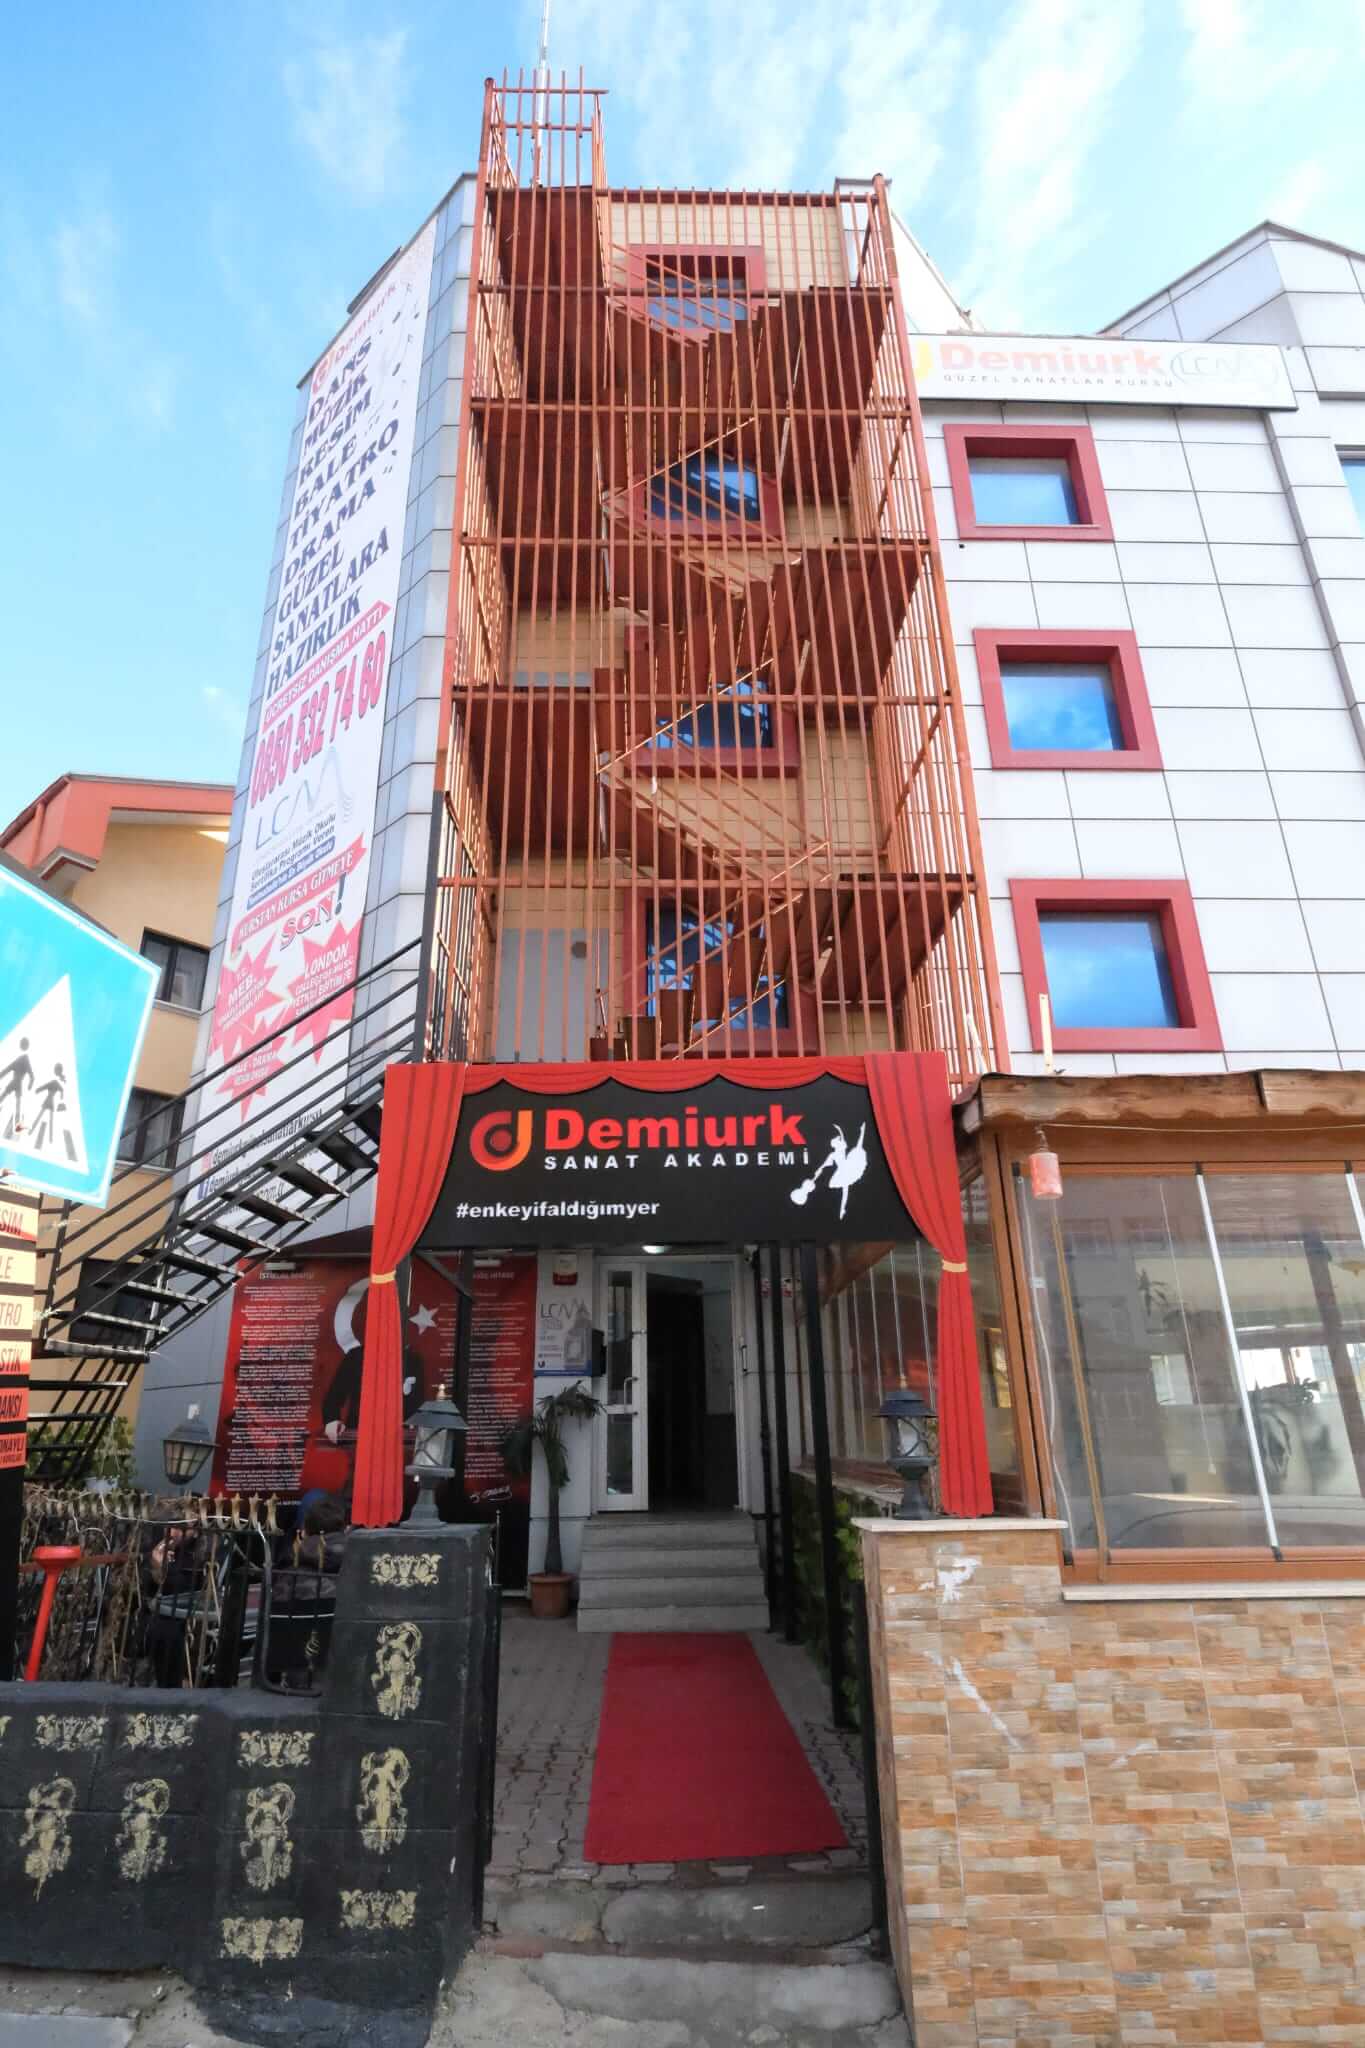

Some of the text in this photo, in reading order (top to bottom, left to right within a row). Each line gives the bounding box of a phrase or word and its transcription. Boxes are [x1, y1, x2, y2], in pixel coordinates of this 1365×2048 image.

[309, 336, 371, 424] DANS
[939, 343, 1166, 376] Demiurk
[299, 388, 371, 485] RESİM
[304, 363, 368, 450] MÜZİK
[290, 419, 398, 550] TİYATRO
[295, 433, 357, 519] BALE
[284, 477, 375, 586] DRAMA
[272, 527, 388, 662] SANATLARA
[279, 541, 343, 623] GÜZEL
[267, 586, 361, 699] HAZIRLIK
[251, 631, 386, 809] 0850 532 74 60
[306, 942, 348, 977] LONDON
[544, 1105, 807, 1148] Demiurk
[544, 1147, 811, 1171] SANAT AKADEMİ
[456, 1200, 661, 1221] #enkeyifaldığımyer
